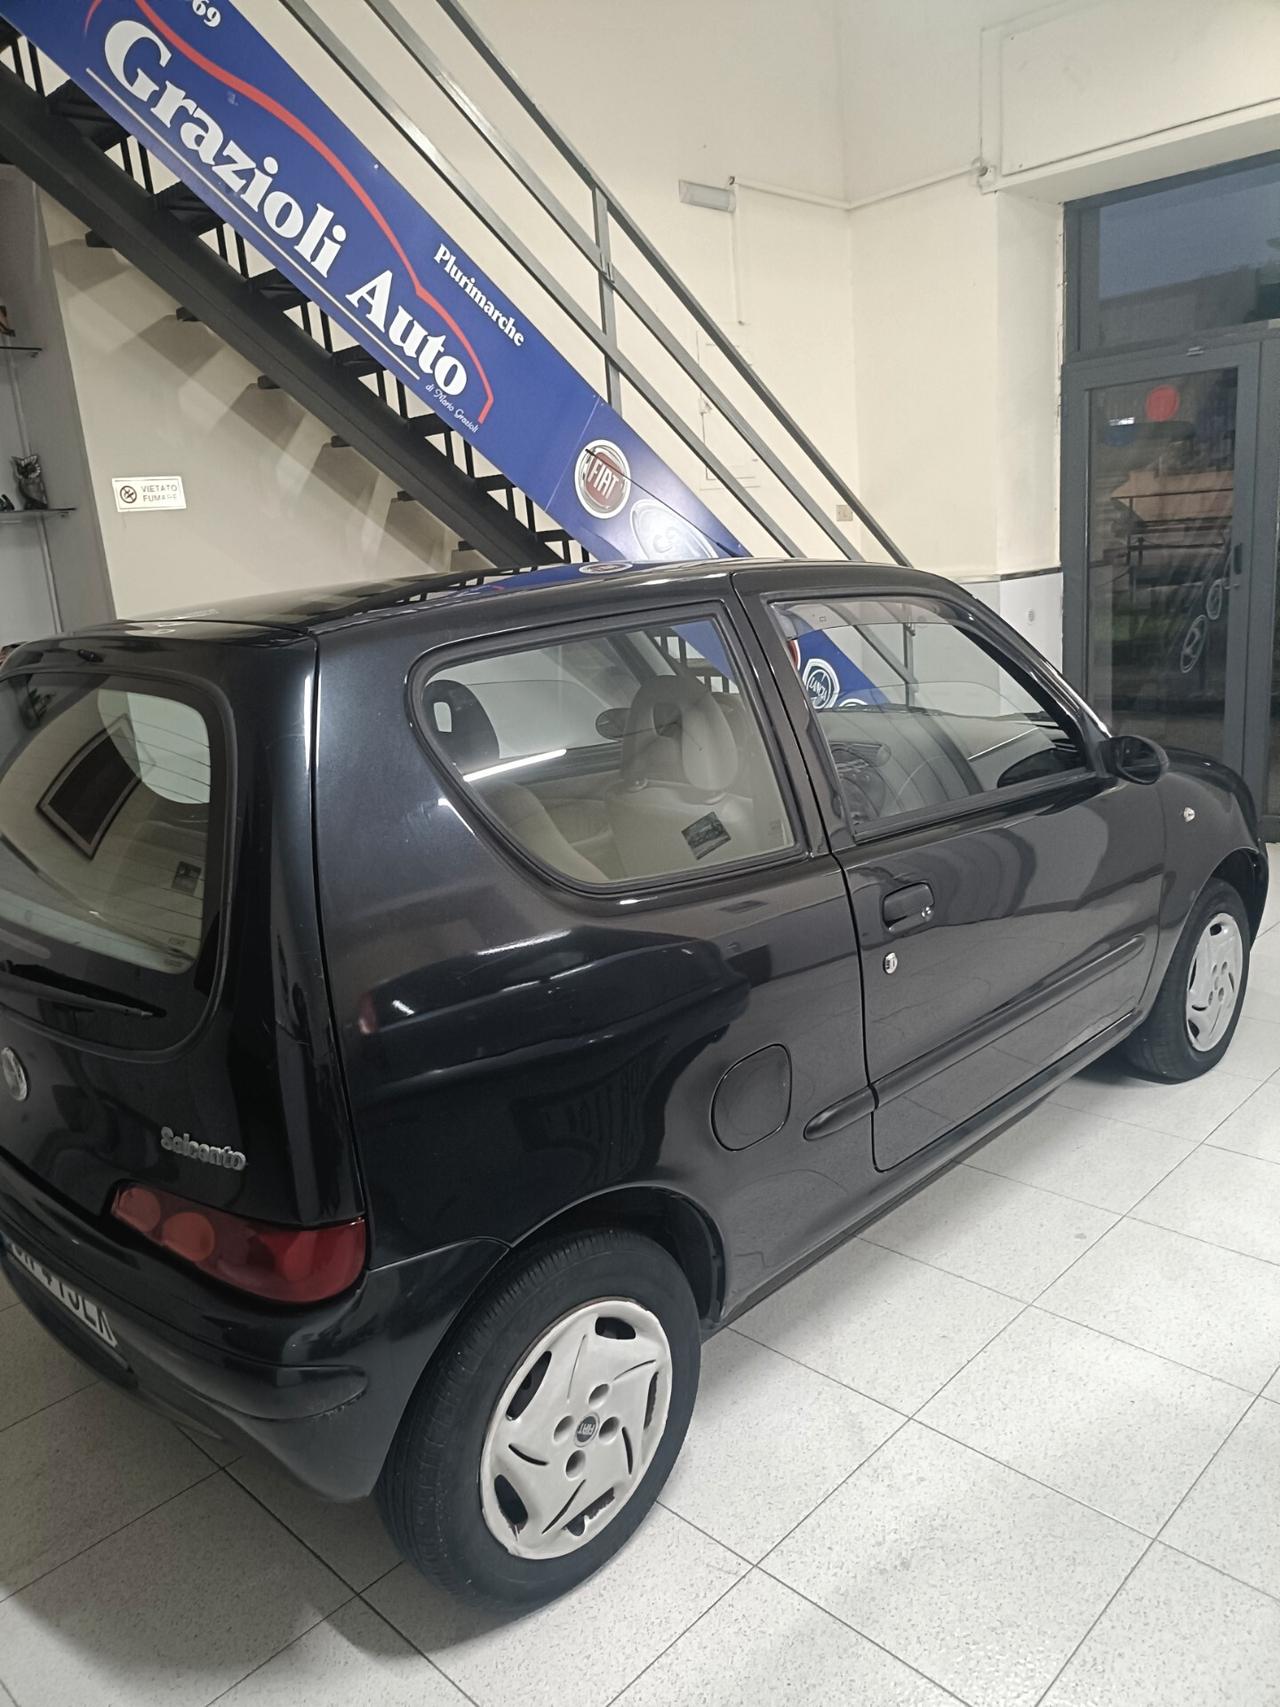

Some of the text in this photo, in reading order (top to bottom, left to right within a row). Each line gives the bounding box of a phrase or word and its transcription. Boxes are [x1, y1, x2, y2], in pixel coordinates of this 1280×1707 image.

[104, 20, 468, 396] Grazioli Auto
[433, 243, 525, 347] Plurimarche
[141, 484, 178, 493] VIETATO
[587, 457, 620, 499] FIAT
